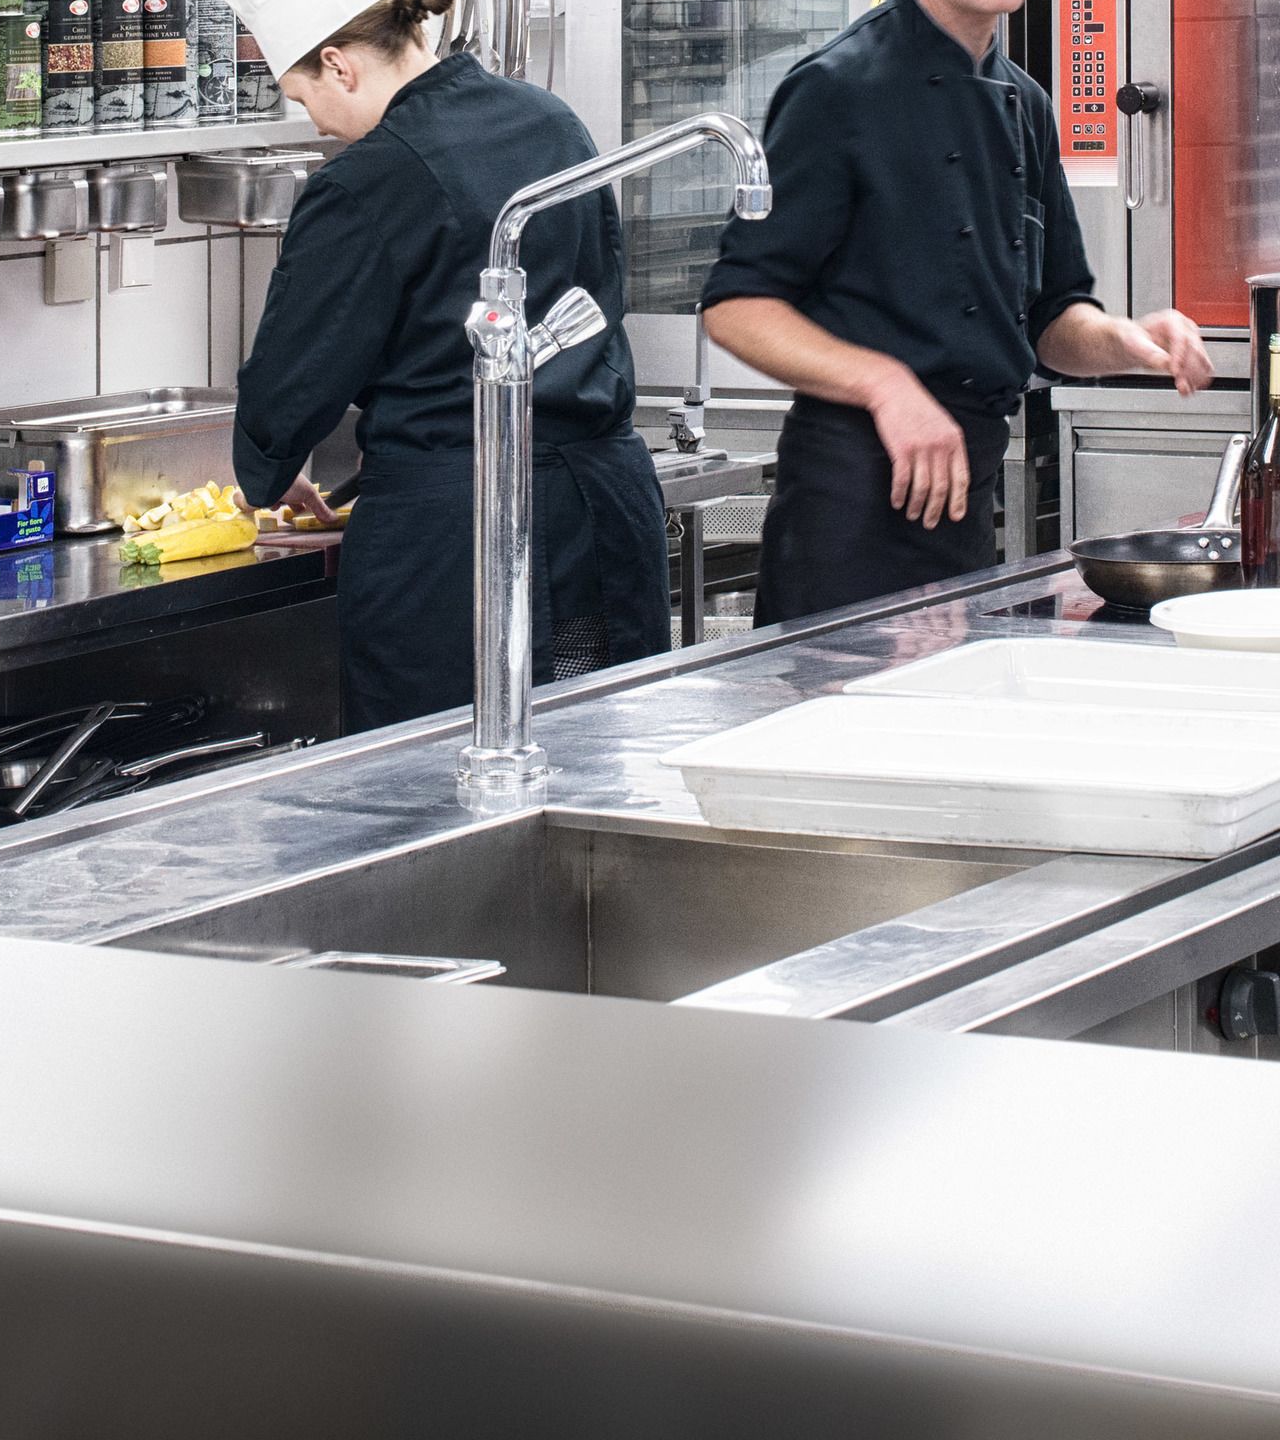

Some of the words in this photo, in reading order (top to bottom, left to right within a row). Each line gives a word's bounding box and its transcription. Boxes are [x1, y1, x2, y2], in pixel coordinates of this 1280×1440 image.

[17, 520, 29, 529] Fior
[29, 517, 43, 527] fiore
[18, 528, 26, 536] di
[25, 526, 42, 536] gusto
